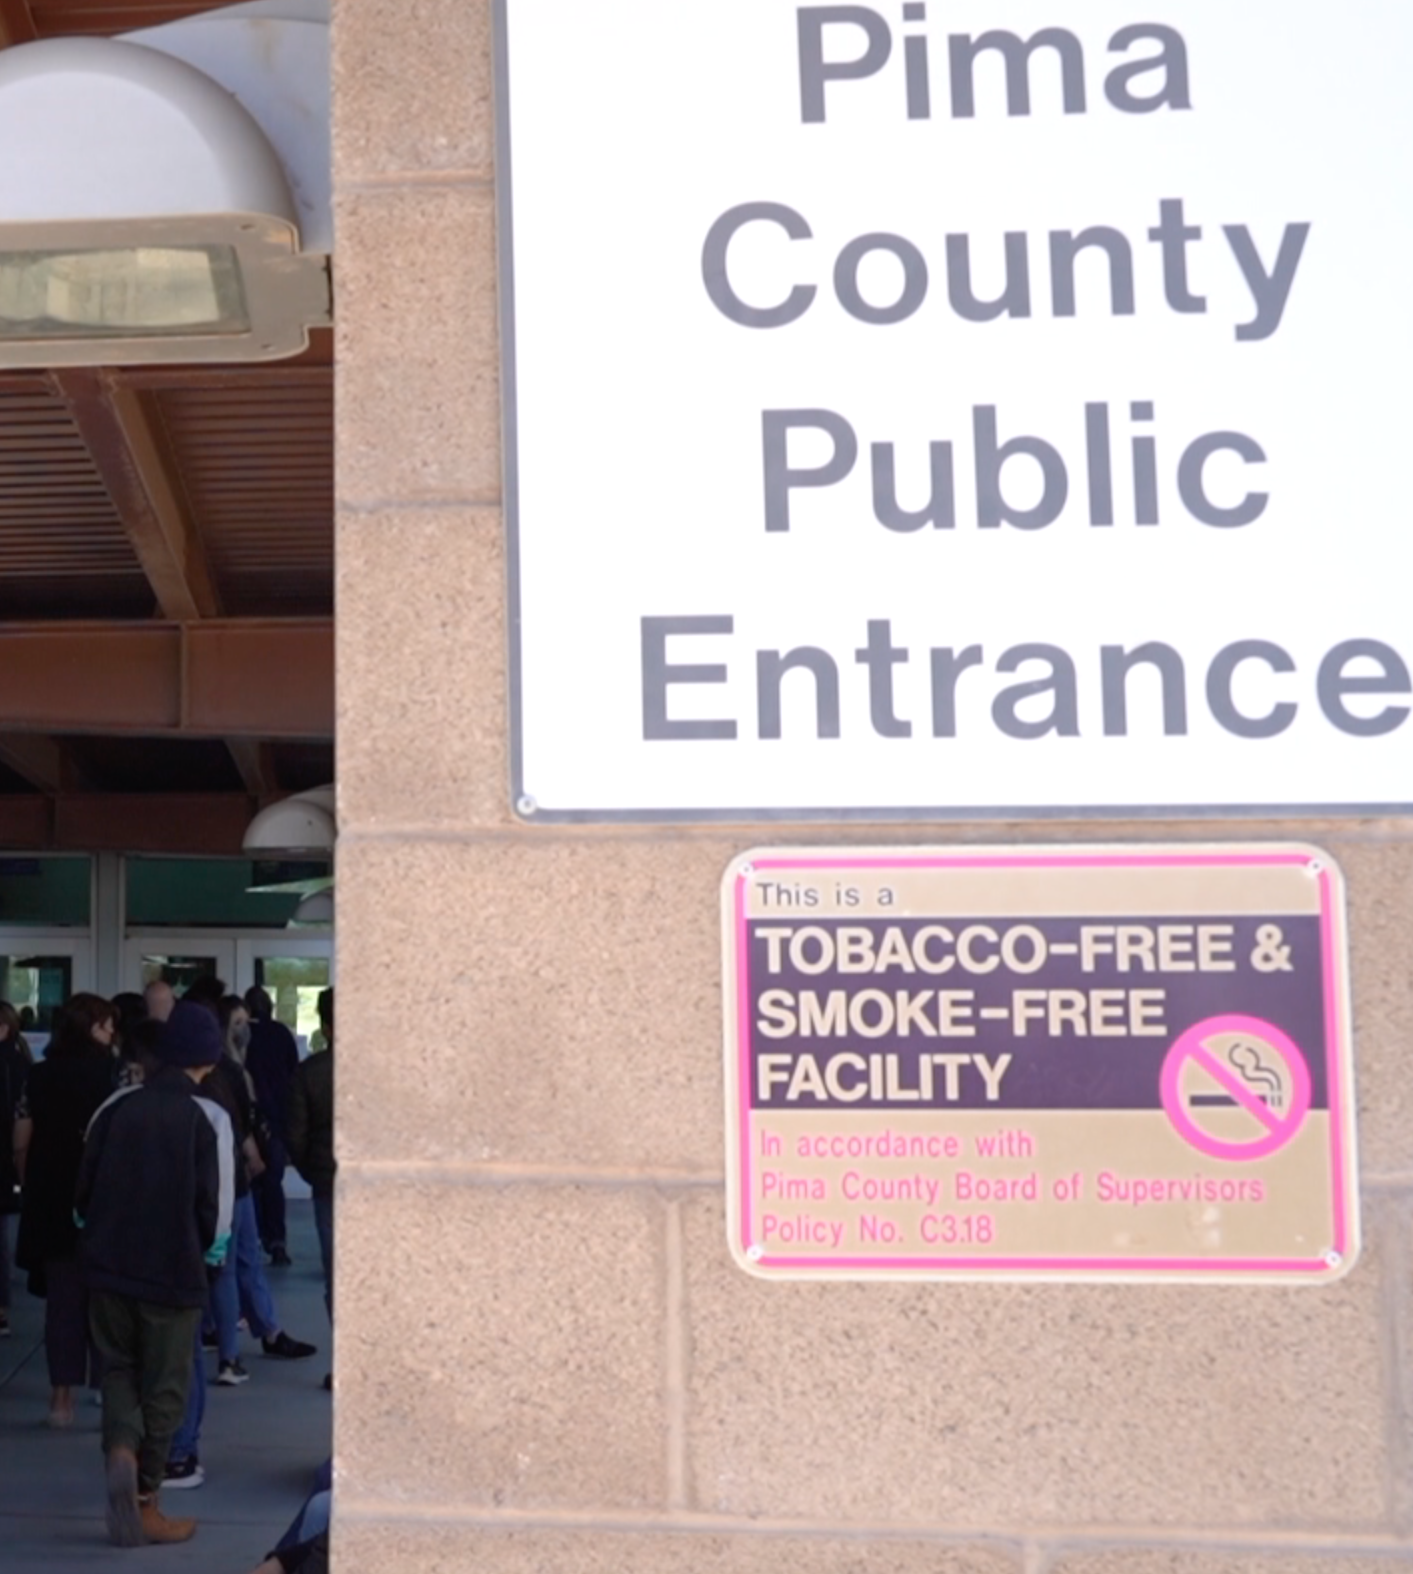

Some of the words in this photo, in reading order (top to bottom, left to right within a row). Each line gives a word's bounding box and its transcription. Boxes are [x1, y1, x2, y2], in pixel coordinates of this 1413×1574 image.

[796, 2, 1193, 124] Pima
[701, 198, 1312, 342] County
[761, 400, 1270, 533] Public
[640, 614, 1413, 741] Entrance
[756, 882, 819, 907] This
[835, 882, 861, 906] is
[877, 886, 894, 906] a
[754, 924, 1237, 975] TOBACCO-FREE
[1249, 923, 1295, 973] &
[756, 988, 1169, 1039] SMOKE-FREE
[757, 1052, 1013, 1103] FACILITY
[760, 1131, 782, 1157] In
[796, 1130, 961, 1158] accordance
[975, 1130, 1033, 1157] with
[761, 1172, 827, 1201] Pima
[841, 1172, 940, 1206] County
[955, 1171, 1038, 1201] Board
[1053, 1172, 1082, 1200] of
[1096, 1171, 1266, 1205] Supervisors
[761, 1214, 845, 1247] Policy
[859, 1214, 905, 1243] No.
